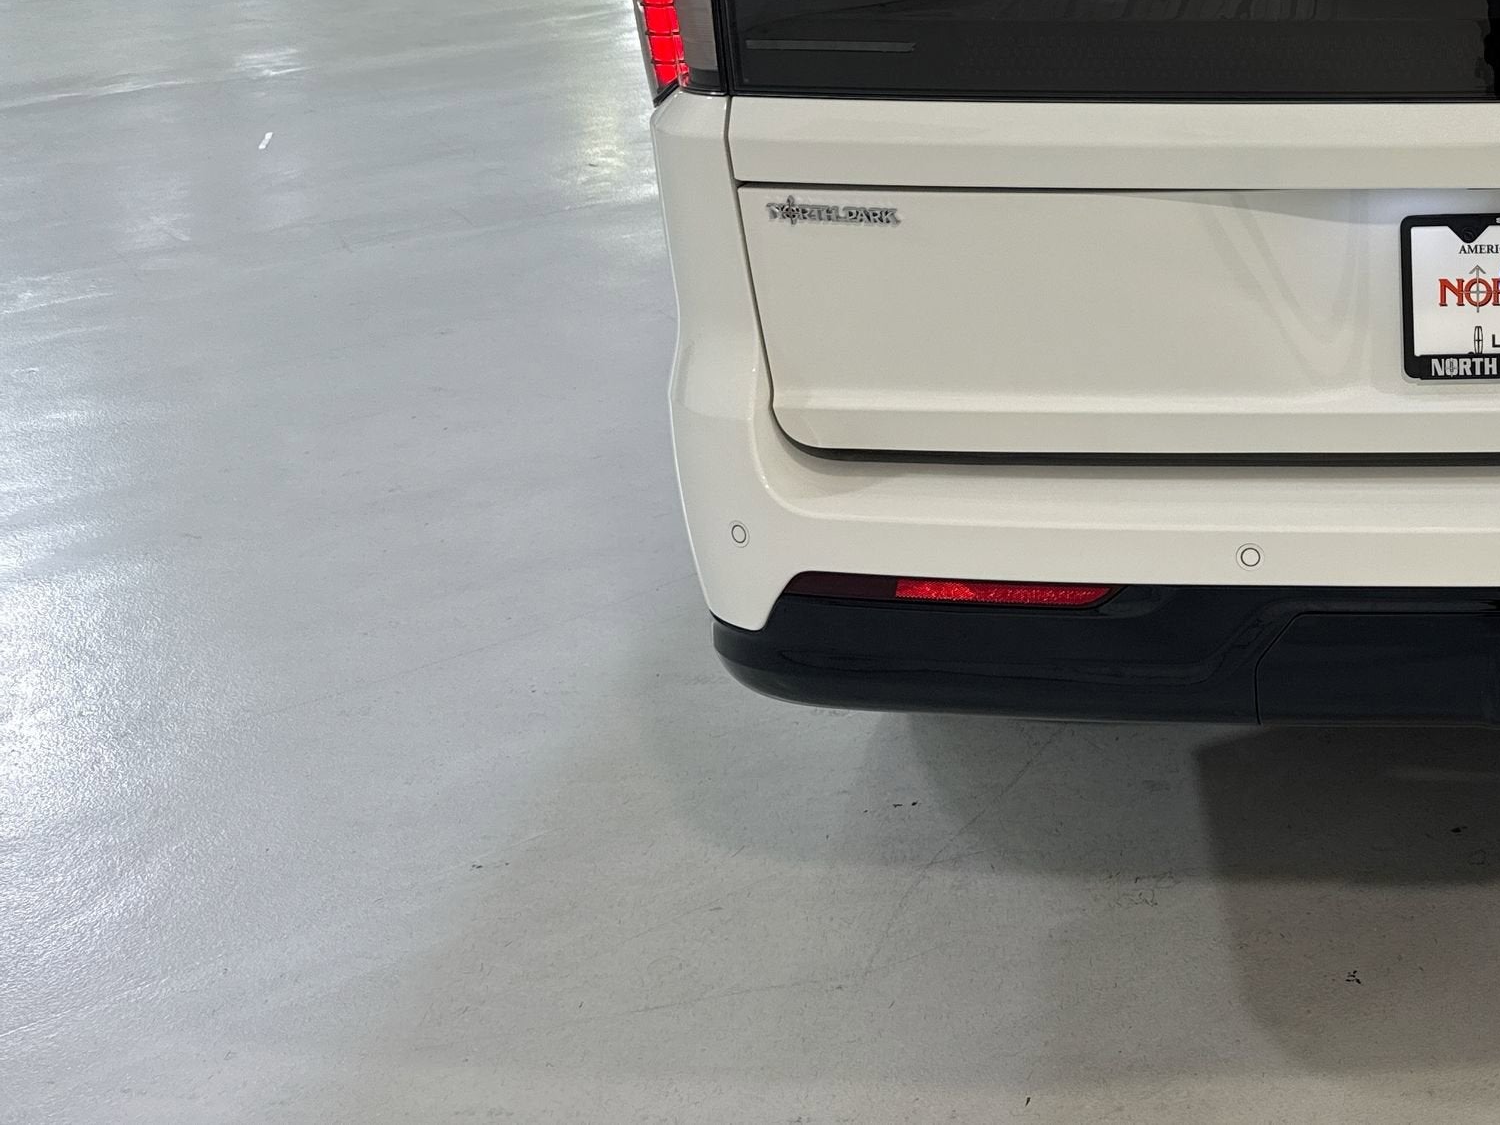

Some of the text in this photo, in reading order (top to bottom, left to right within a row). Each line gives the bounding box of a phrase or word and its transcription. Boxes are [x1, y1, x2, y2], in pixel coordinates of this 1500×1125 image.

[766, 202, 900, 225] NORTH PARK
[1431, 357, 1498, 377] NORTH
